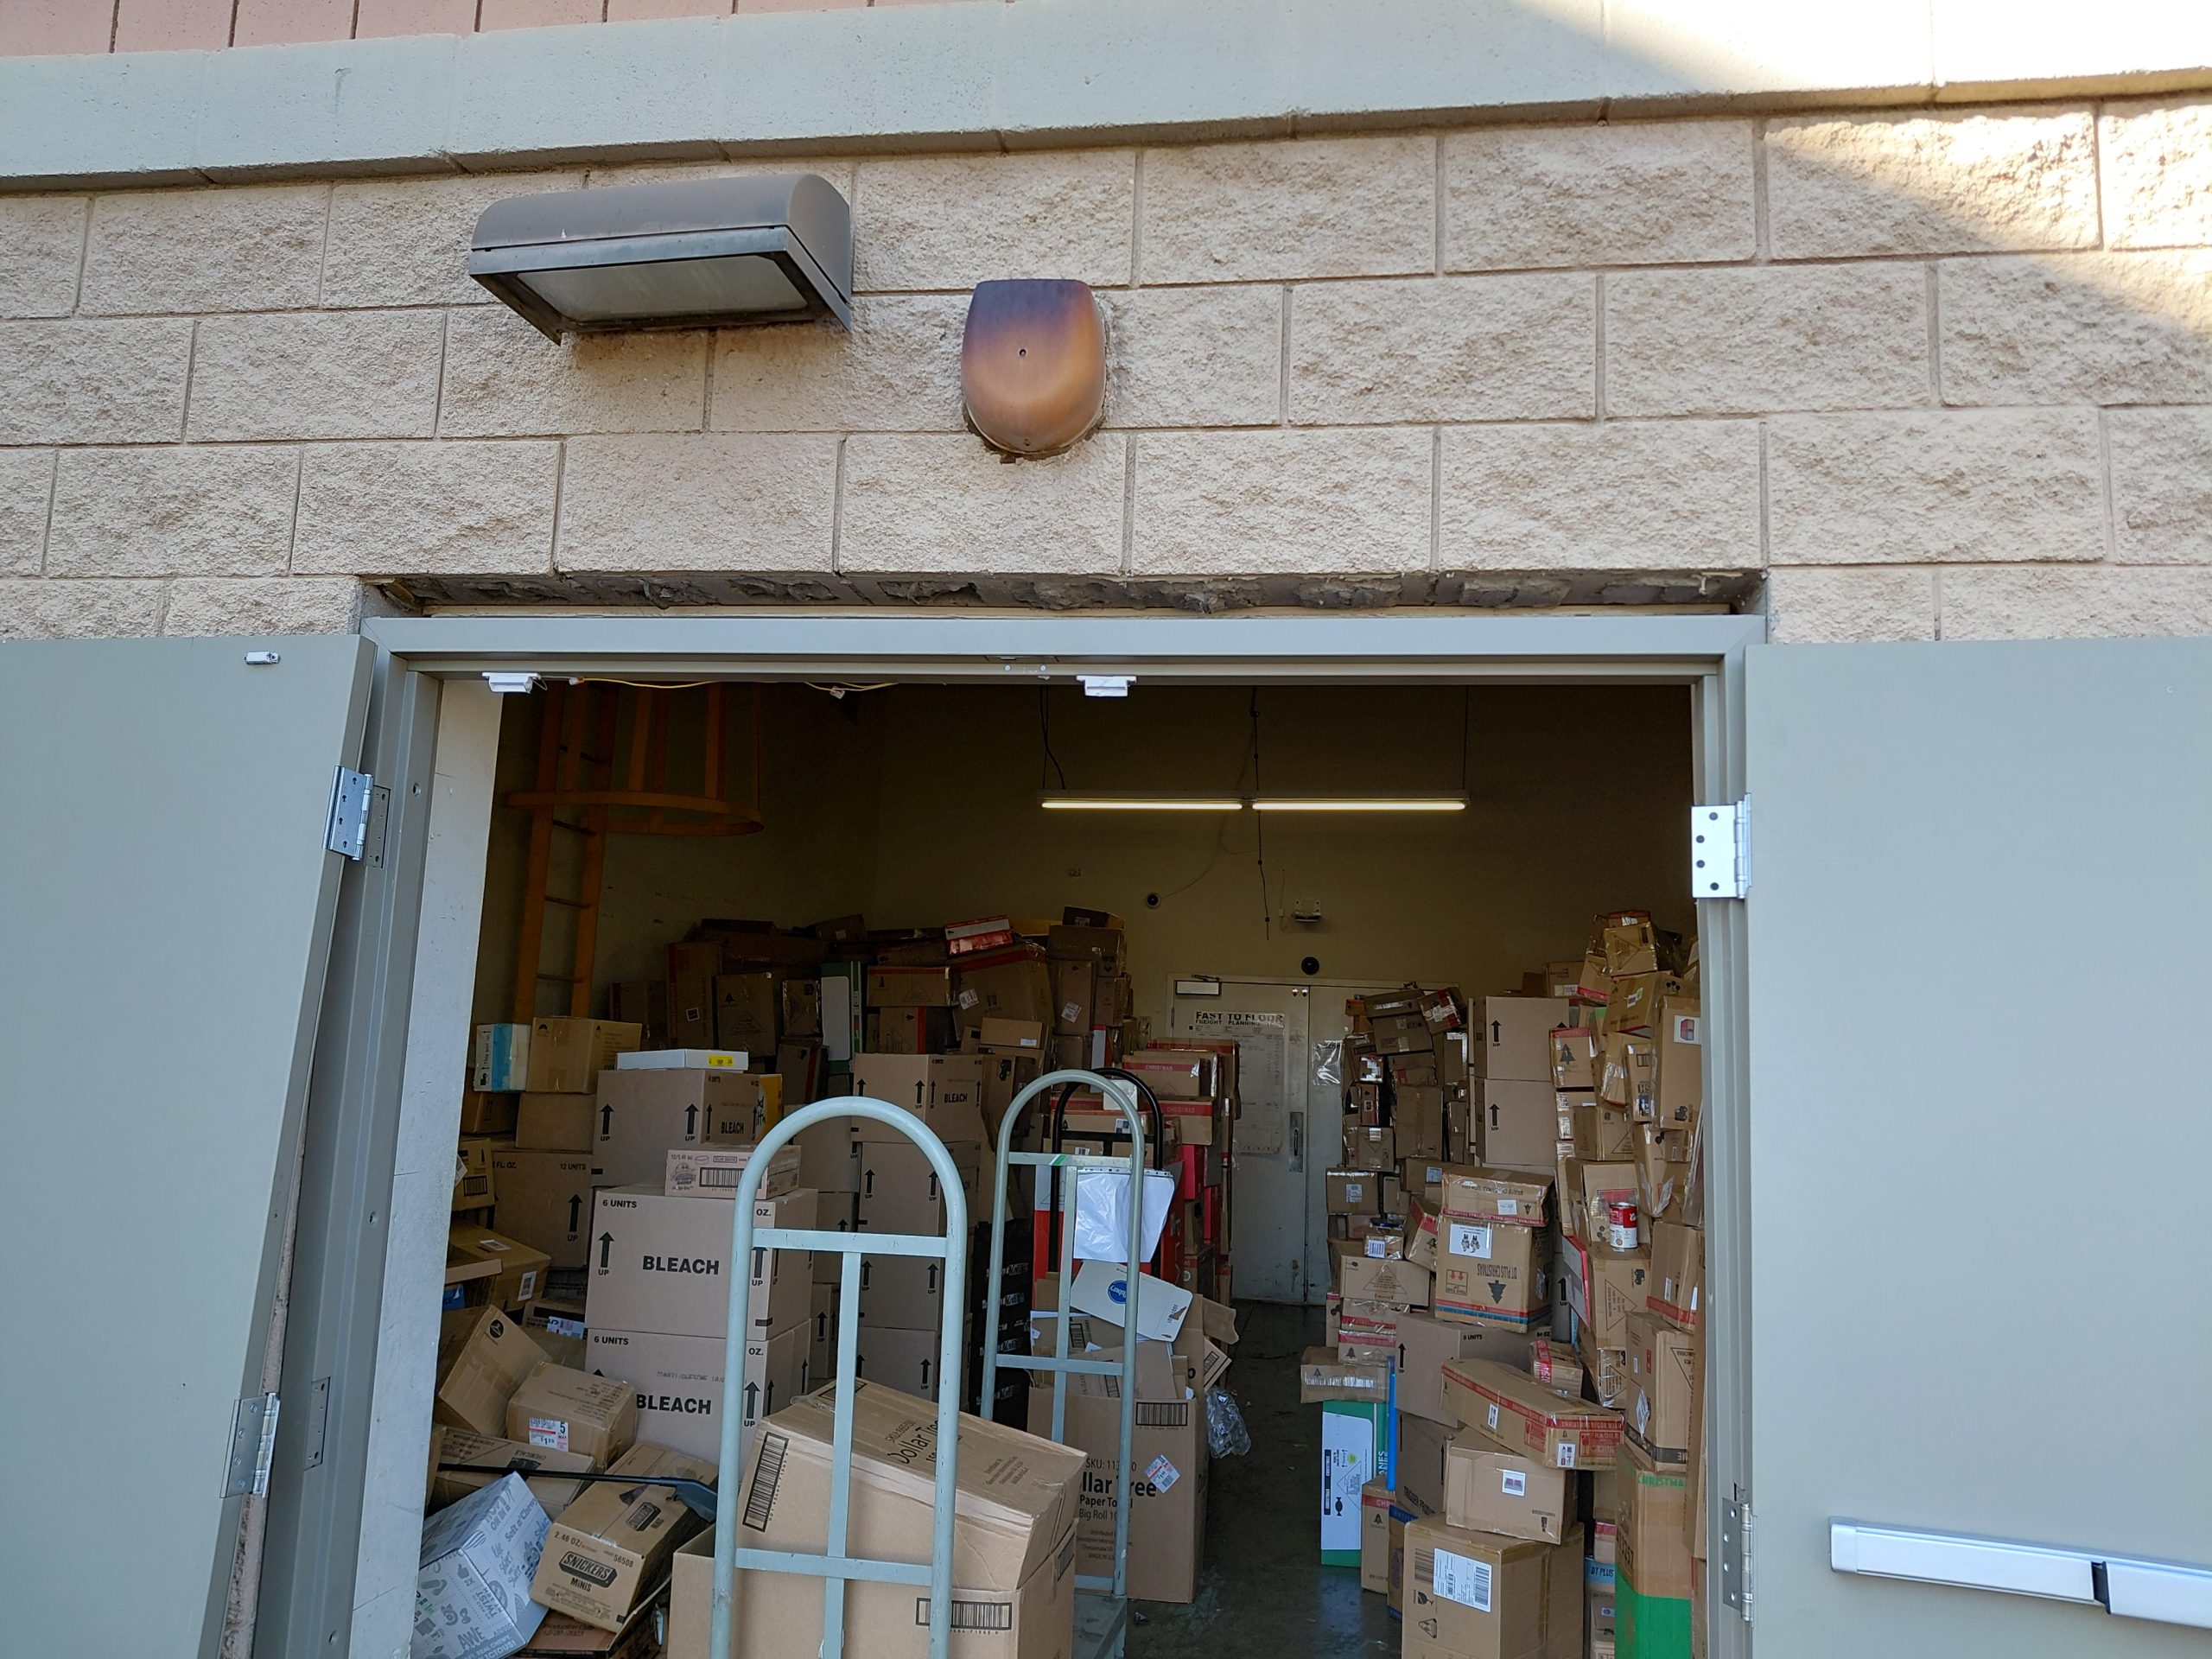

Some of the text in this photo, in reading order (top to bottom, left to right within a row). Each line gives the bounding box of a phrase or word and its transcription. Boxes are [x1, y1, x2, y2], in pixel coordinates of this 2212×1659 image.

[1196, 1011, 1224, 1020] FAST
[1245, 1014, 1283, 1023] FLOOR
[944, 1093, 968, 1103] BLEACH
[721, 1122, 744, 1135] BLEACH
[567, 1234, 578, 1243] UP
[642, 1255, 720, 1275] BLEACH
[1477, 1262, 1517, 1280] DT PLUS CHRISTMAS
[601, 1337, 629, 1345] UNITS
[637, 1394, 712, 1415] BLEACH
[559, 1421, 566, 1434] 5
[1085, 1458, 1105, 1470] SKU:
[1107, 1459, 1137, 1472] 110
[1082, 1471, 1113, 1494] llar
[1637, 1473, 1684, 1488] CHRISTMA
[1080, 1495, 1134, 1510] Paper Tol
[1079, 1509, 1091, 1521] Big
[1093, 1510, 1108, 1521] Roll
[505, 1523, 518, 1542] Soft
[554, 1531, 570, 1543] 2.48
[564, 1553, 612, 1580] SNICKERS
[613, 1554, 634, 1568] 56508
[1590, 1566, 1614, 1578] DT PLUS
[476, 1591, 499, 1618] TWIST
[458, 1626, 486, 1650] AWE
